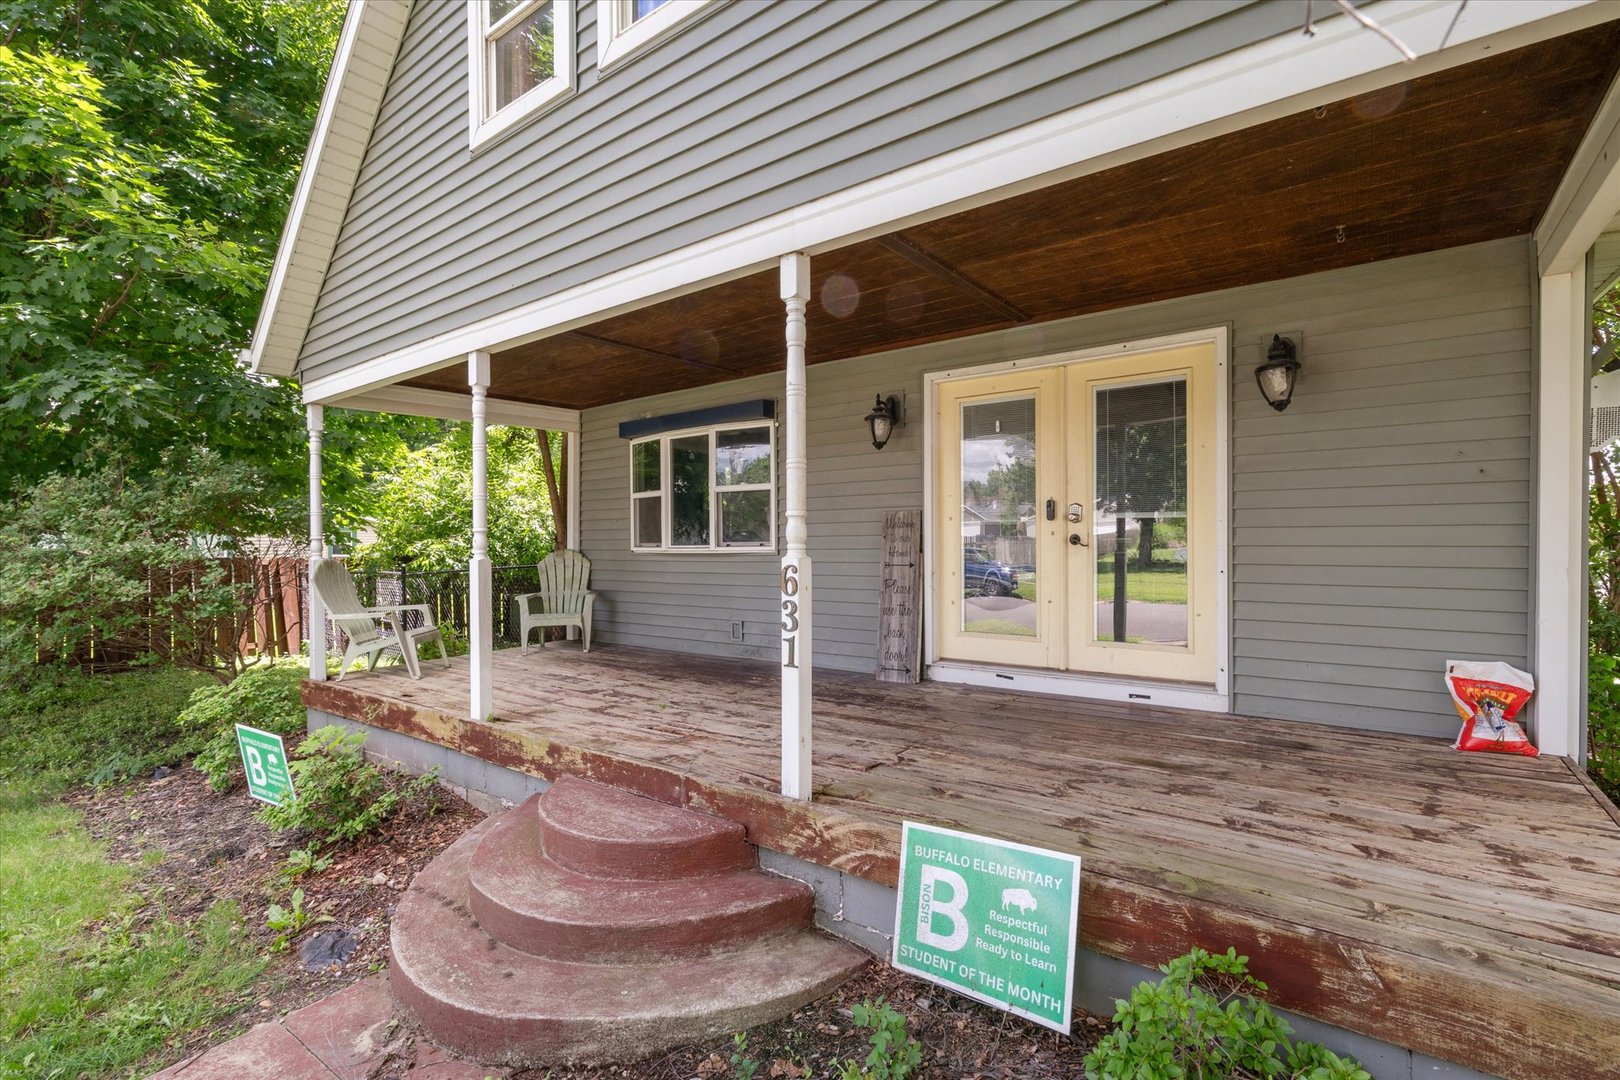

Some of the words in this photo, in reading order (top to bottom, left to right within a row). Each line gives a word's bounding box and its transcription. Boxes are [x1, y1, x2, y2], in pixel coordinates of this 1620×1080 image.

[883, 578, 912, 594] Please
[780, 564, 799, 669] 631
[882, 606, 895, 616] use
[897, 601, 912, 616] the
[887, 622, 906, 639] back
[884, 645, 908, 662] door!
[245, 745, 267, 787] B
[914, 845, 970, 868] BUFFALO
[973, 858, 1063, 890] ELEMENTARY
[915, 863, 969, 953] B
[921, 883, 932, 924] BISON
[984, 924, 1051, 954] Responsible
[989, 910, 1048, 936] Respectful
[975, 937, 1009, 960] Ready
[1010, 950, 1022, 962] to
[1024, 954, 1057, 974] Learn
[900, 944, 957, 974] STUDENT
[959, 964, 976, 980] OF
[978, 970, 1005, 993] THE
[1007, 982, 1062, 1015] MONTH
